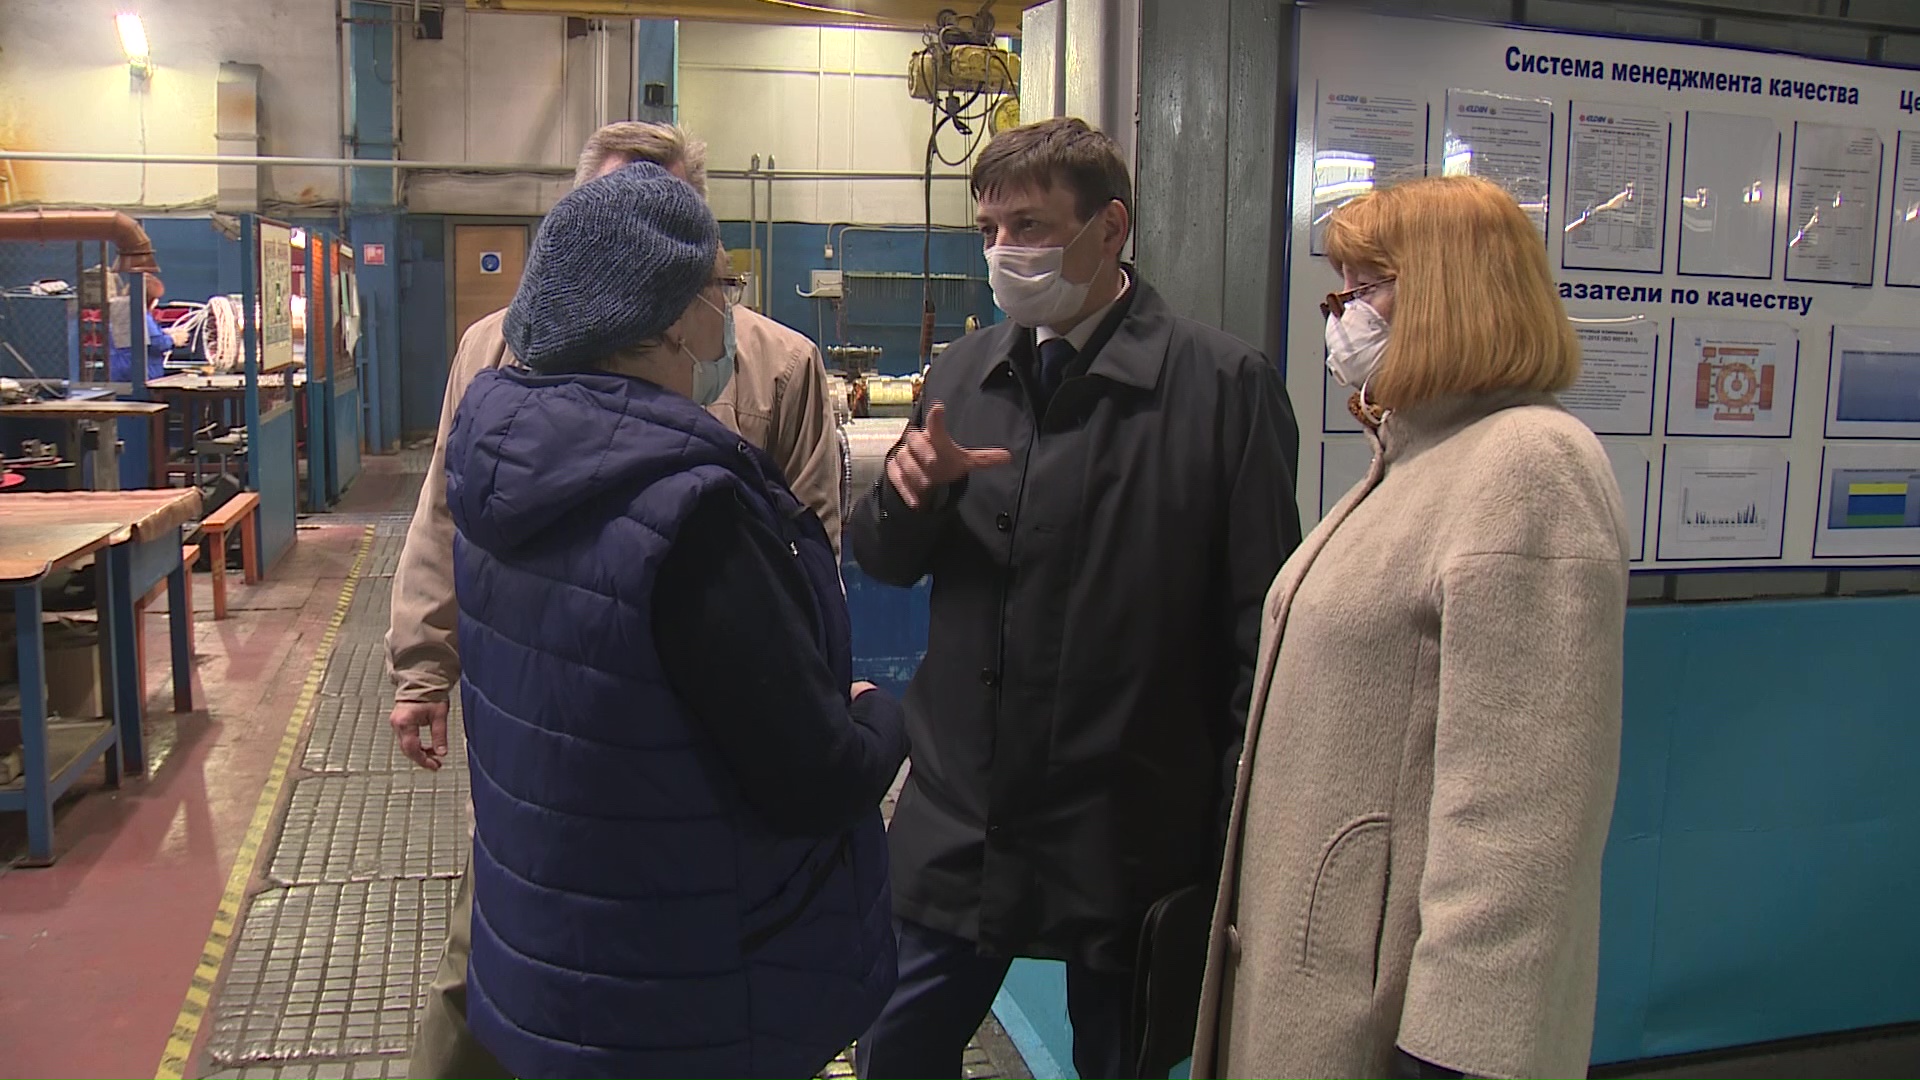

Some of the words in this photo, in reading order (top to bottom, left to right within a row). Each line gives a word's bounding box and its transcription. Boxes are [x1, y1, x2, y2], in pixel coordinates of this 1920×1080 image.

[1505, 46, 1604, 79] Система
[1612, 62, 1762, 95] менеджмента
[1769, 77, 1859, 105] качества
[1555, 282, 1662, 303] азатели
[1671, 289, 1699, 304] по
[1707, 290, 1813, 316] качеству
